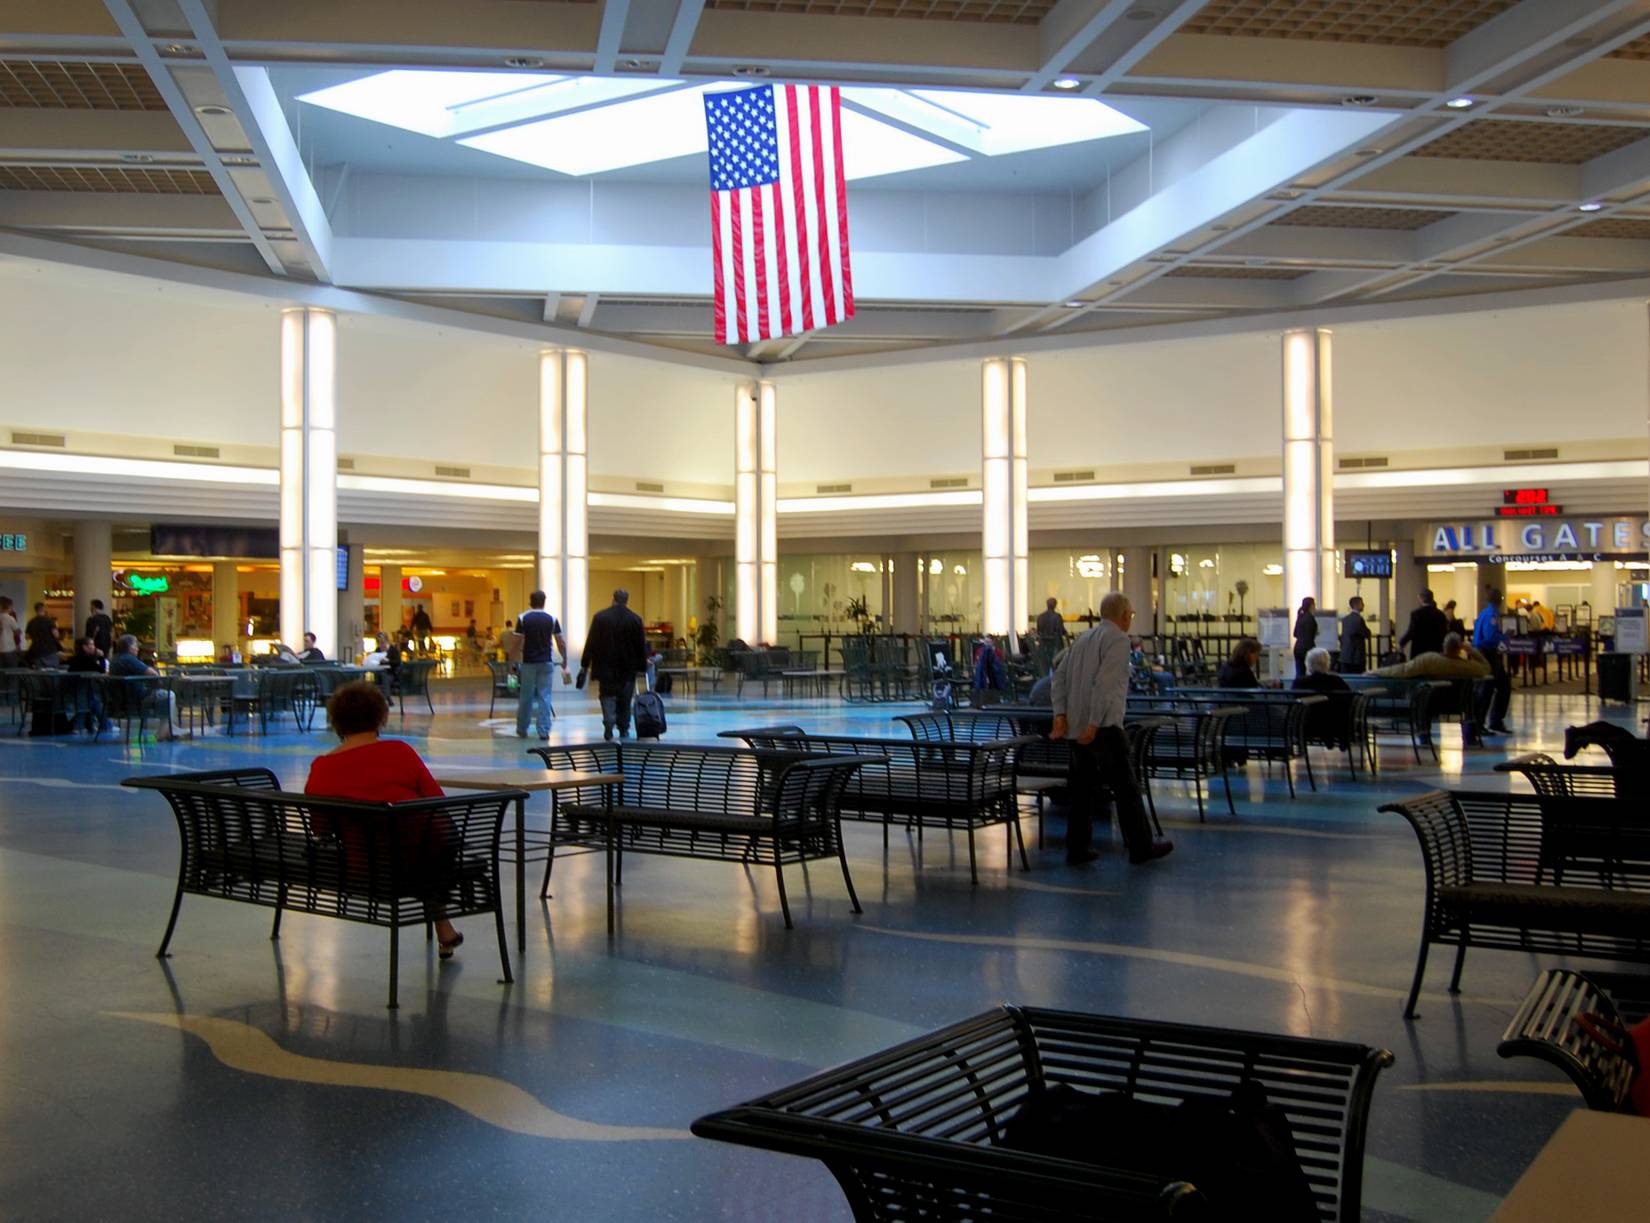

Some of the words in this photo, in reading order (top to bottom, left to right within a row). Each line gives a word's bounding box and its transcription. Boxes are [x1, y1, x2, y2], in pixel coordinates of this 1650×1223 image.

[1432, 525, 1496, 551] ALL
[1488, 553, 1554, 564] Concourses
[1559, 552, 1568, 562] A
[1593, 552, 1601, 562] C
